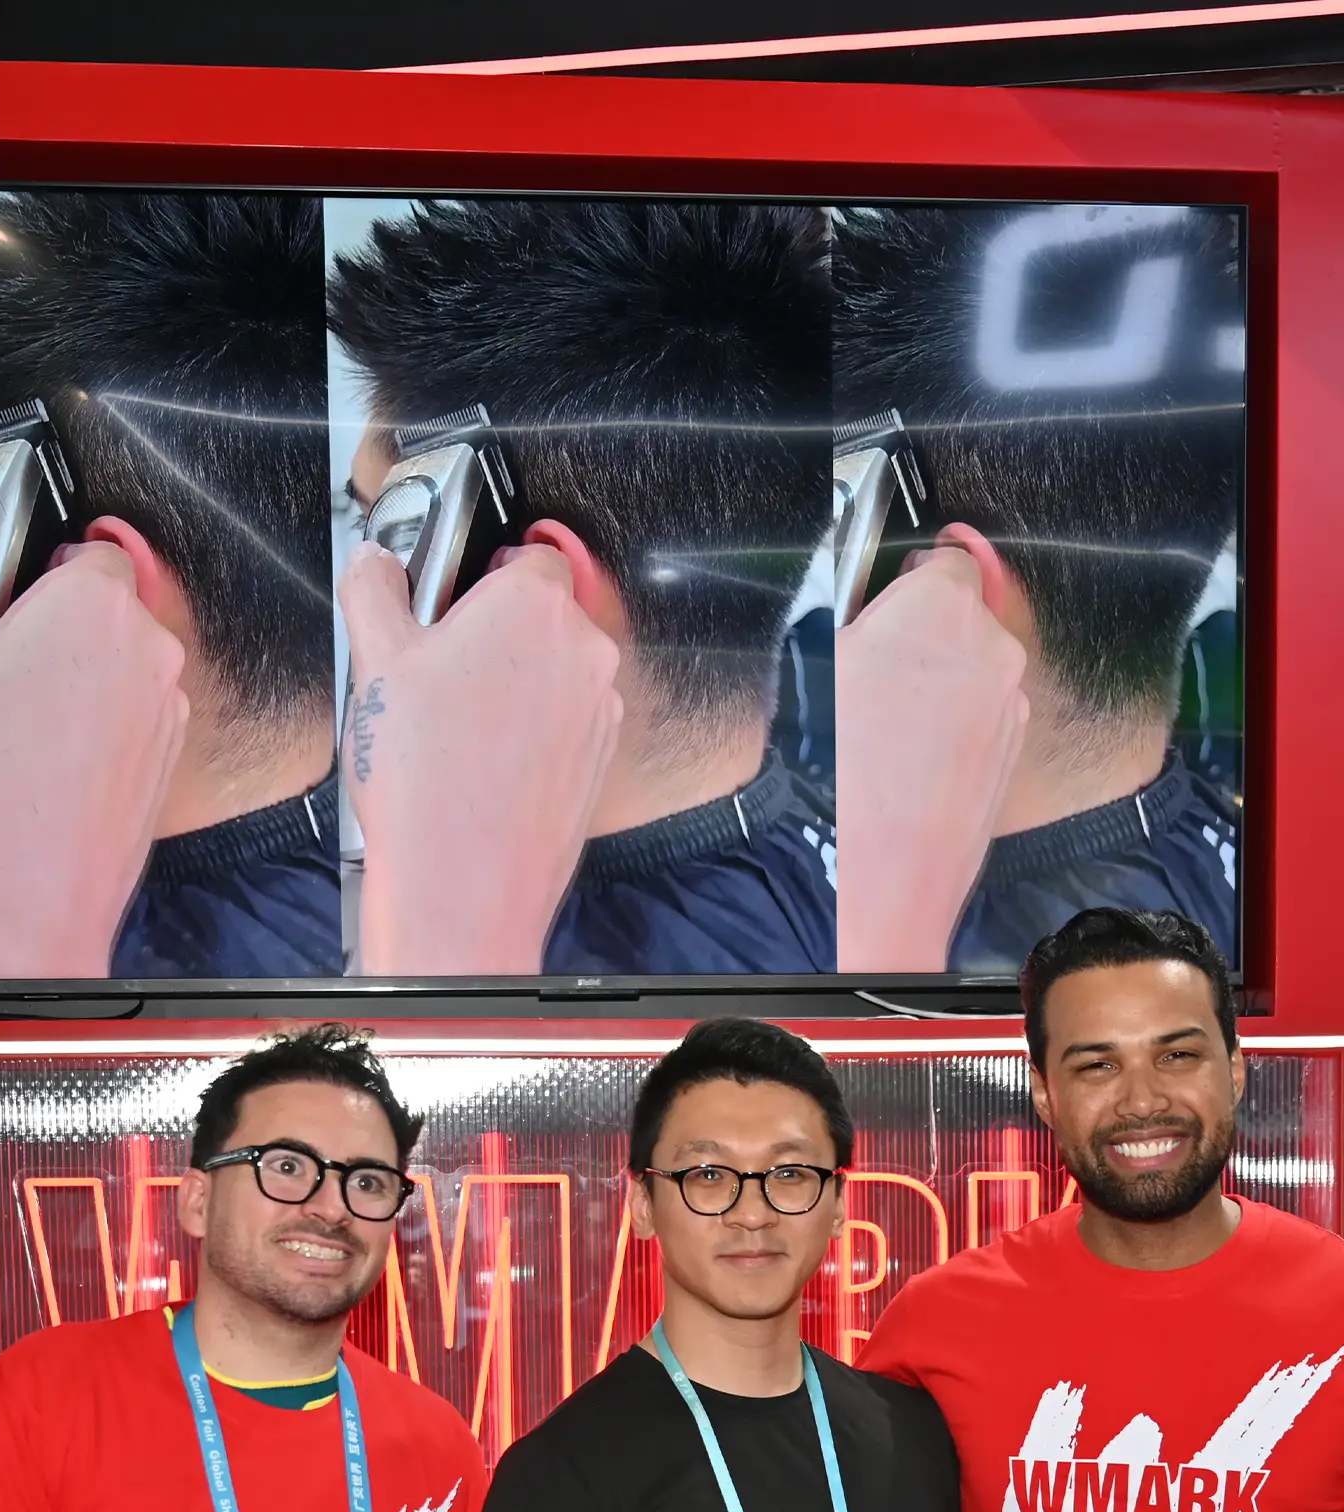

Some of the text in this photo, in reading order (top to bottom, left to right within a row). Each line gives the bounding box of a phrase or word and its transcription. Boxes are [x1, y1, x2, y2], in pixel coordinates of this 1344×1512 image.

[189, 1374, 206, 1414] Canton
[202, 1418, 215, 1443] Fair
[209, 1449, 228, 1493] Global
